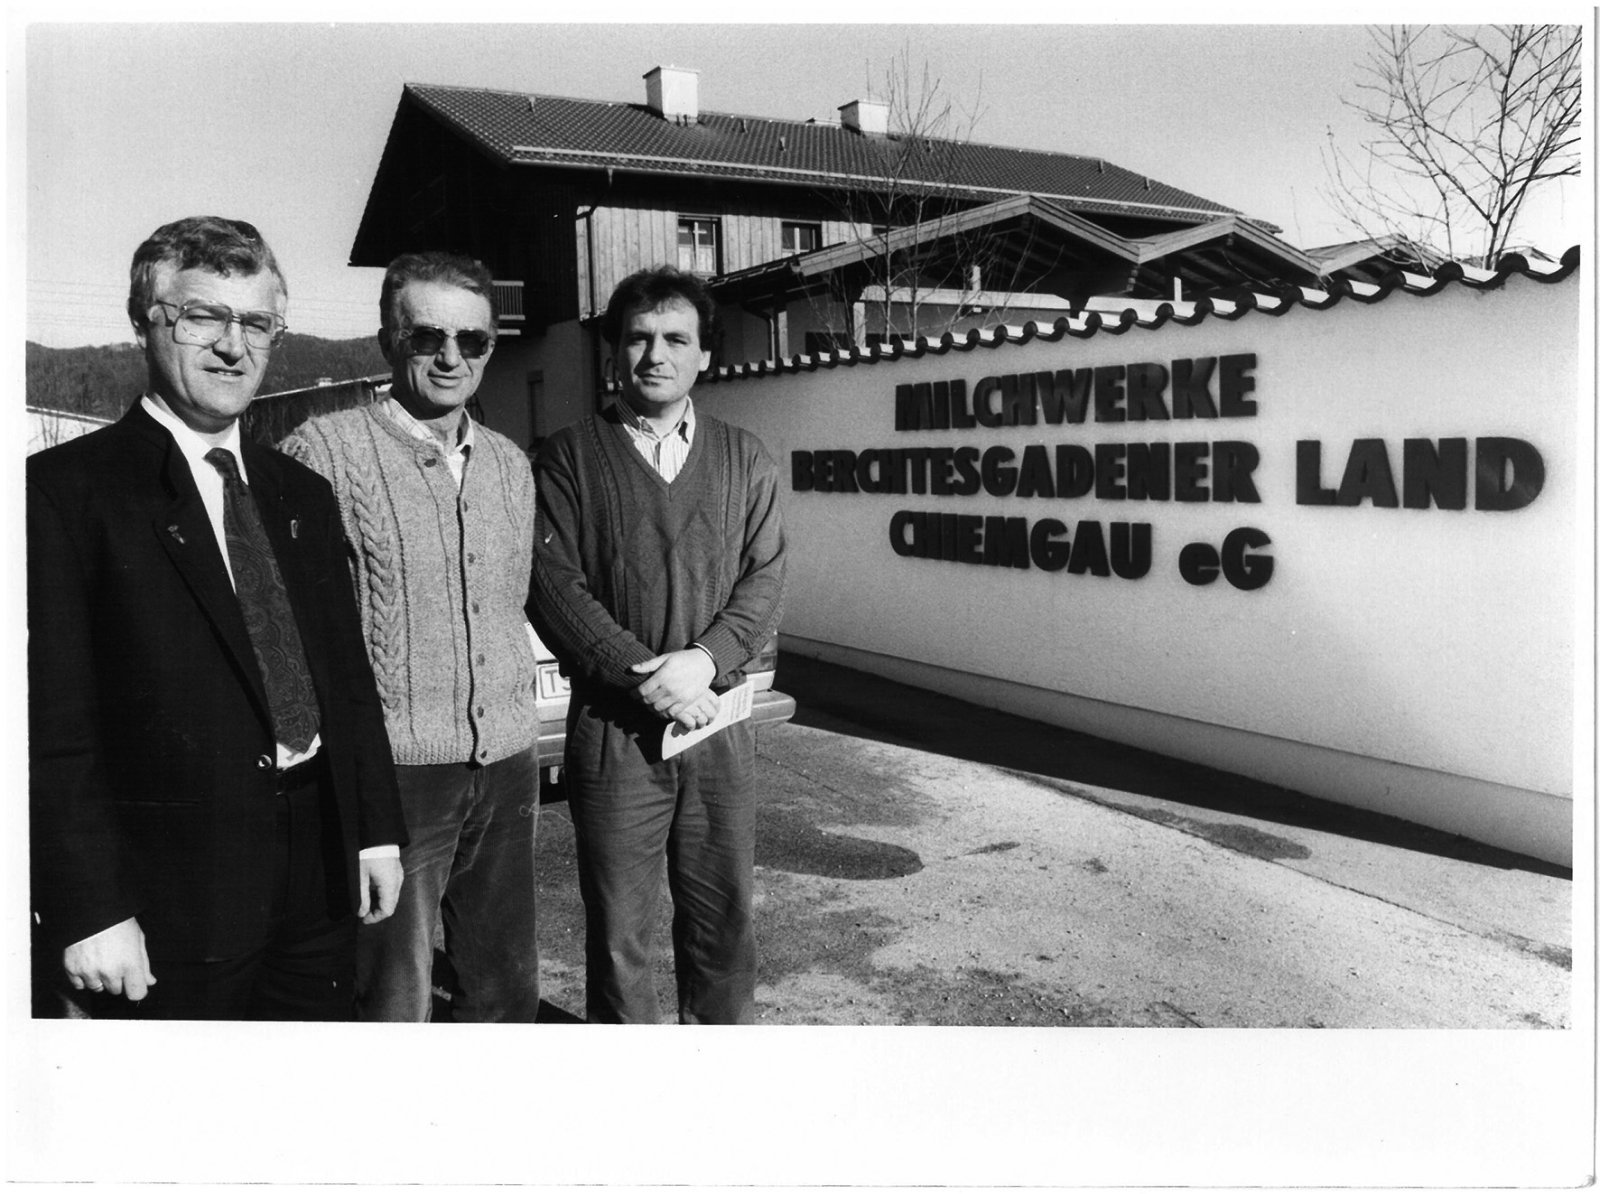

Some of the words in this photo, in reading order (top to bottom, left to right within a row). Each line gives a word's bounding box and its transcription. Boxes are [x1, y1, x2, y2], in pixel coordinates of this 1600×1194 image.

[894, 353, 1257, 432] MILCHWERKE
[791, 441, 1261, 503] BERCHTESGADENER
[1296, 436, 1545, 511] LAND
[889, 510, 1152, 580] CHIEMGAU
[1178, 526, 1275, 591] eG
